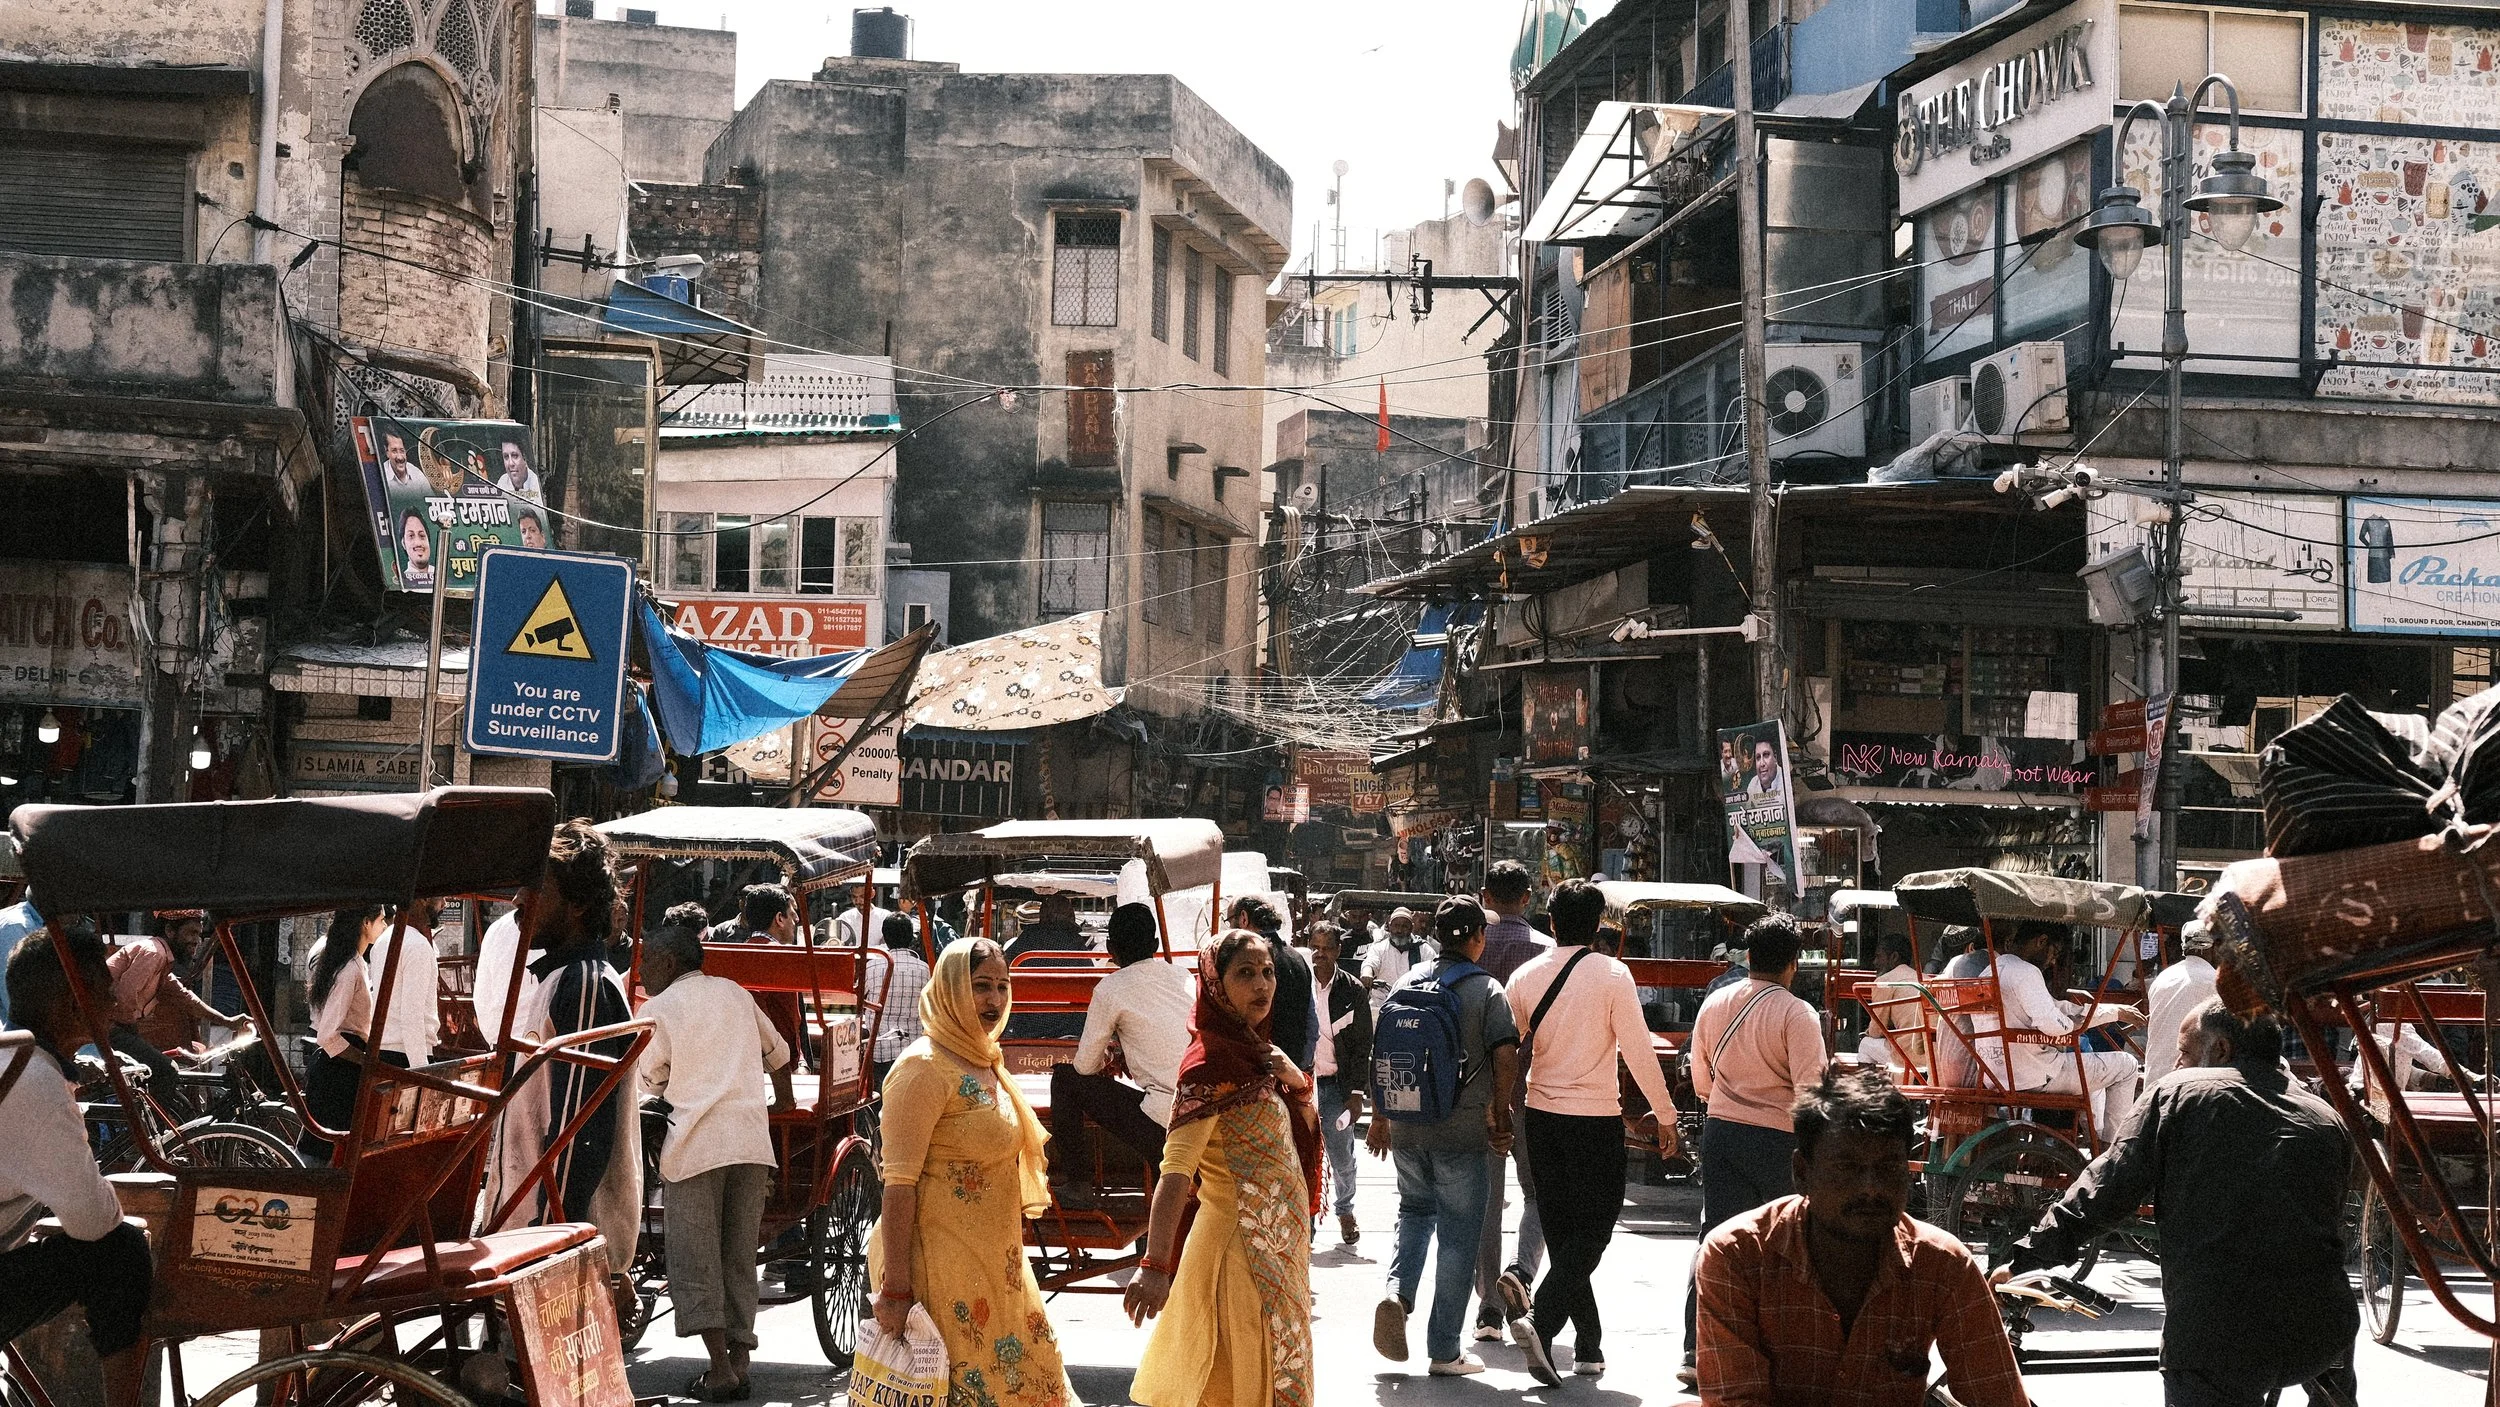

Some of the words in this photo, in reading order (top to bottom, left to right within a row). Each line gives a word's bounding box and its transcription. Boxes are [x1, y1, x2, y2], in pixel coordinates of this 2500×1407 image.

[2364, 74, 2381, 82] YOUR
[1919, 78, 1976, 161] THE
[1979, 18, 2094, 132] CHOWK
[2335, 138, 2354, 148] LIFE
[2337, 166, 2351, 174] TEA
[2362, 217, 2379, 225] YOUR
[2324, 233, 2350, 242] ENJOY
[2323, 377, 2348, 386] ENJOY
[2458, 385, 2483, 394] ENJOY
[81, 599, 125, 650] Co.
[678, 605, 814, 641] AZAD
[2399, 617, 2429, 625] GROUND
[2430, 618, 2455, 626] FLOOR,
[2456, 619, 2488, 627] CHANDNI
[513, 681, 547, 698] You
[552, 688, 581, 702] are
[491, 702, 544, 718] under
[548, 705, 600, 723] CCTV
[487, 720, 599, 743] Surveillance
[297, 757, 366, 774] ISLAMIA
[1842, 743, 1883, 774] NK
[1890, 747, 1926, 766] New
[1933, 748, 2004, 769] Karnal
[2045, 765, 2095, 784] Wear
[852, 767, 893, 782] Penalty
[902, 757, 1011, 783] ANDAR
[1303, 763, 1333, 776] Baba
[1355, 793, 1382, 805] 767
[1728, 806, 1747, 826] माहे
[1747, 805, 1784, 826] रमज़ान
[1396, 1018, 1420, 1029] NIKE
[214, 1194, 292, 1231] G20
[178, 1263, 223, 1274] MUNICIPAL
[224, 1267, 283, 1281] CORPORATION
[548, 1336, 566, 1377] की
[872, 1382, 934, 1407] KUMAR
